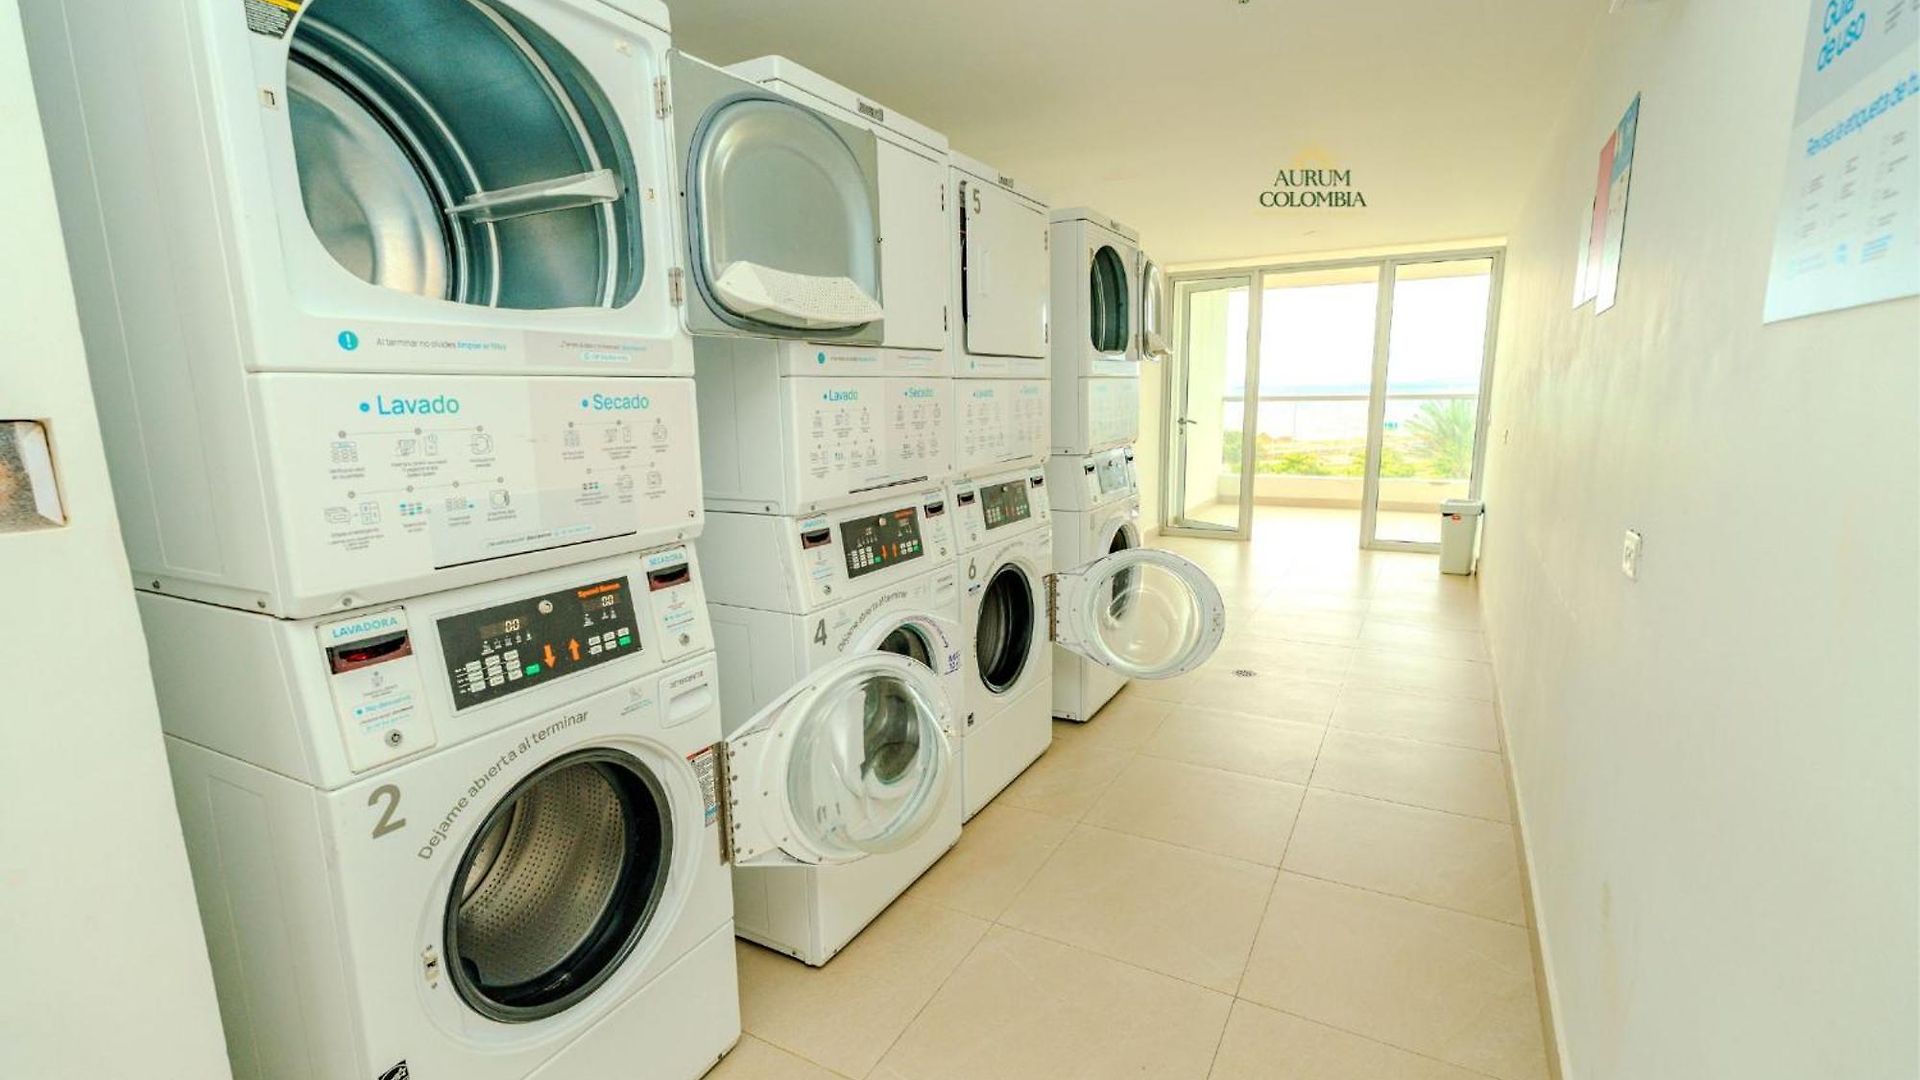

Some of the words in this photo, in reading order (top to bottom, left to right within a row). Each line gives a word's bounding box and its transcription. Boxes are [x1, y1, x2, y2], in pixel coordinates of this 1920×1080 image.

[972, 188, 982, 215] 5
[376, 394, 460, 415] Lavado
[592, 393, 650, 410] Secado
[828, 388, 858, 402] Lavado
[968, 557, 977, 580] 6
[332, 616, 398, 639] LAVADORA
[505, 618, 520, 633] 00
[813, 618, 828, 646] 4
[417, 796, 469, 860] Dejame
[467, 749, 519, 799] abierta
[517, 737, 531, 754] al
[531, 711, 589, 745] terminar
[367, 784, 407, 840] 2
